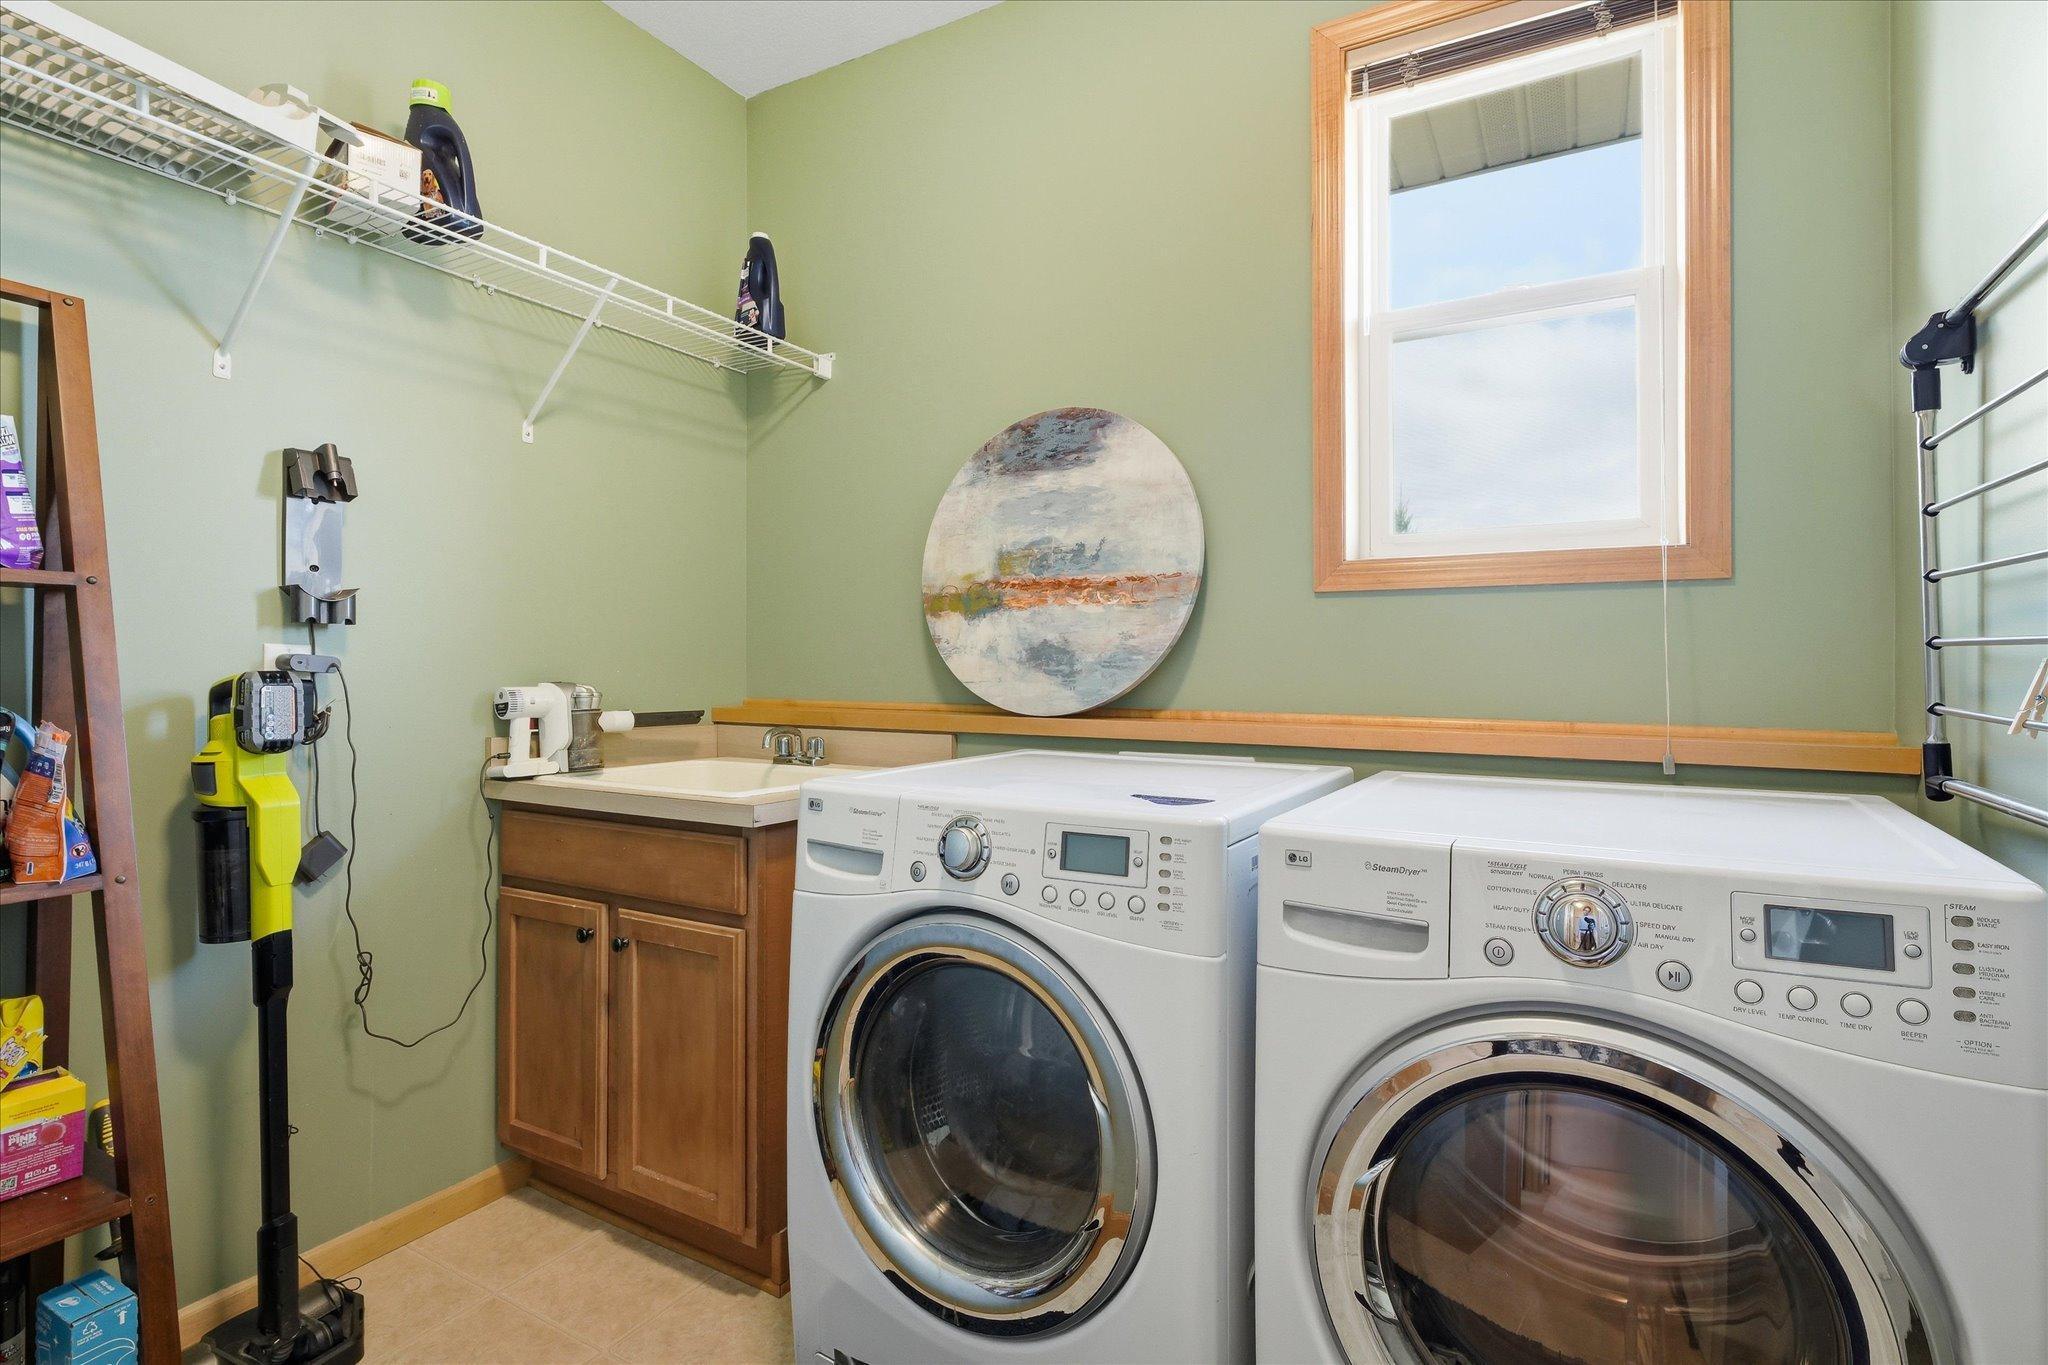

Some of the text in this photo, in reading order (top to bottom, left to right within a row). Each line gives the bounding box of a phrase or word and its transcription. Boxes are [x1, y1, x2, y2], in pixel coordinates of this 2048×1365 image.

[1528, 872, 1555, 881] NORMAL
[1611, 881, 1648, 891] DELICATES
[1630, 900, 1684, 911] ULTRA DELICATE
[1949, 903, 1977, 911] STEAM
[1639, 921, 1661, 930] SPEED
[1654, 933, 1680, 941] MANUAL
[1637, 941, 1649, 949] AIR
[1797, 1015, 1829, 1025] CONTROL
[1839, 1021, 1873, 1031] TIME DRY
[1900, 1030, 1929, 1040] BEEPER
[1963, 1039, 1993, 1049] OPTION
[8, 1131, 38, 1147] PINK
